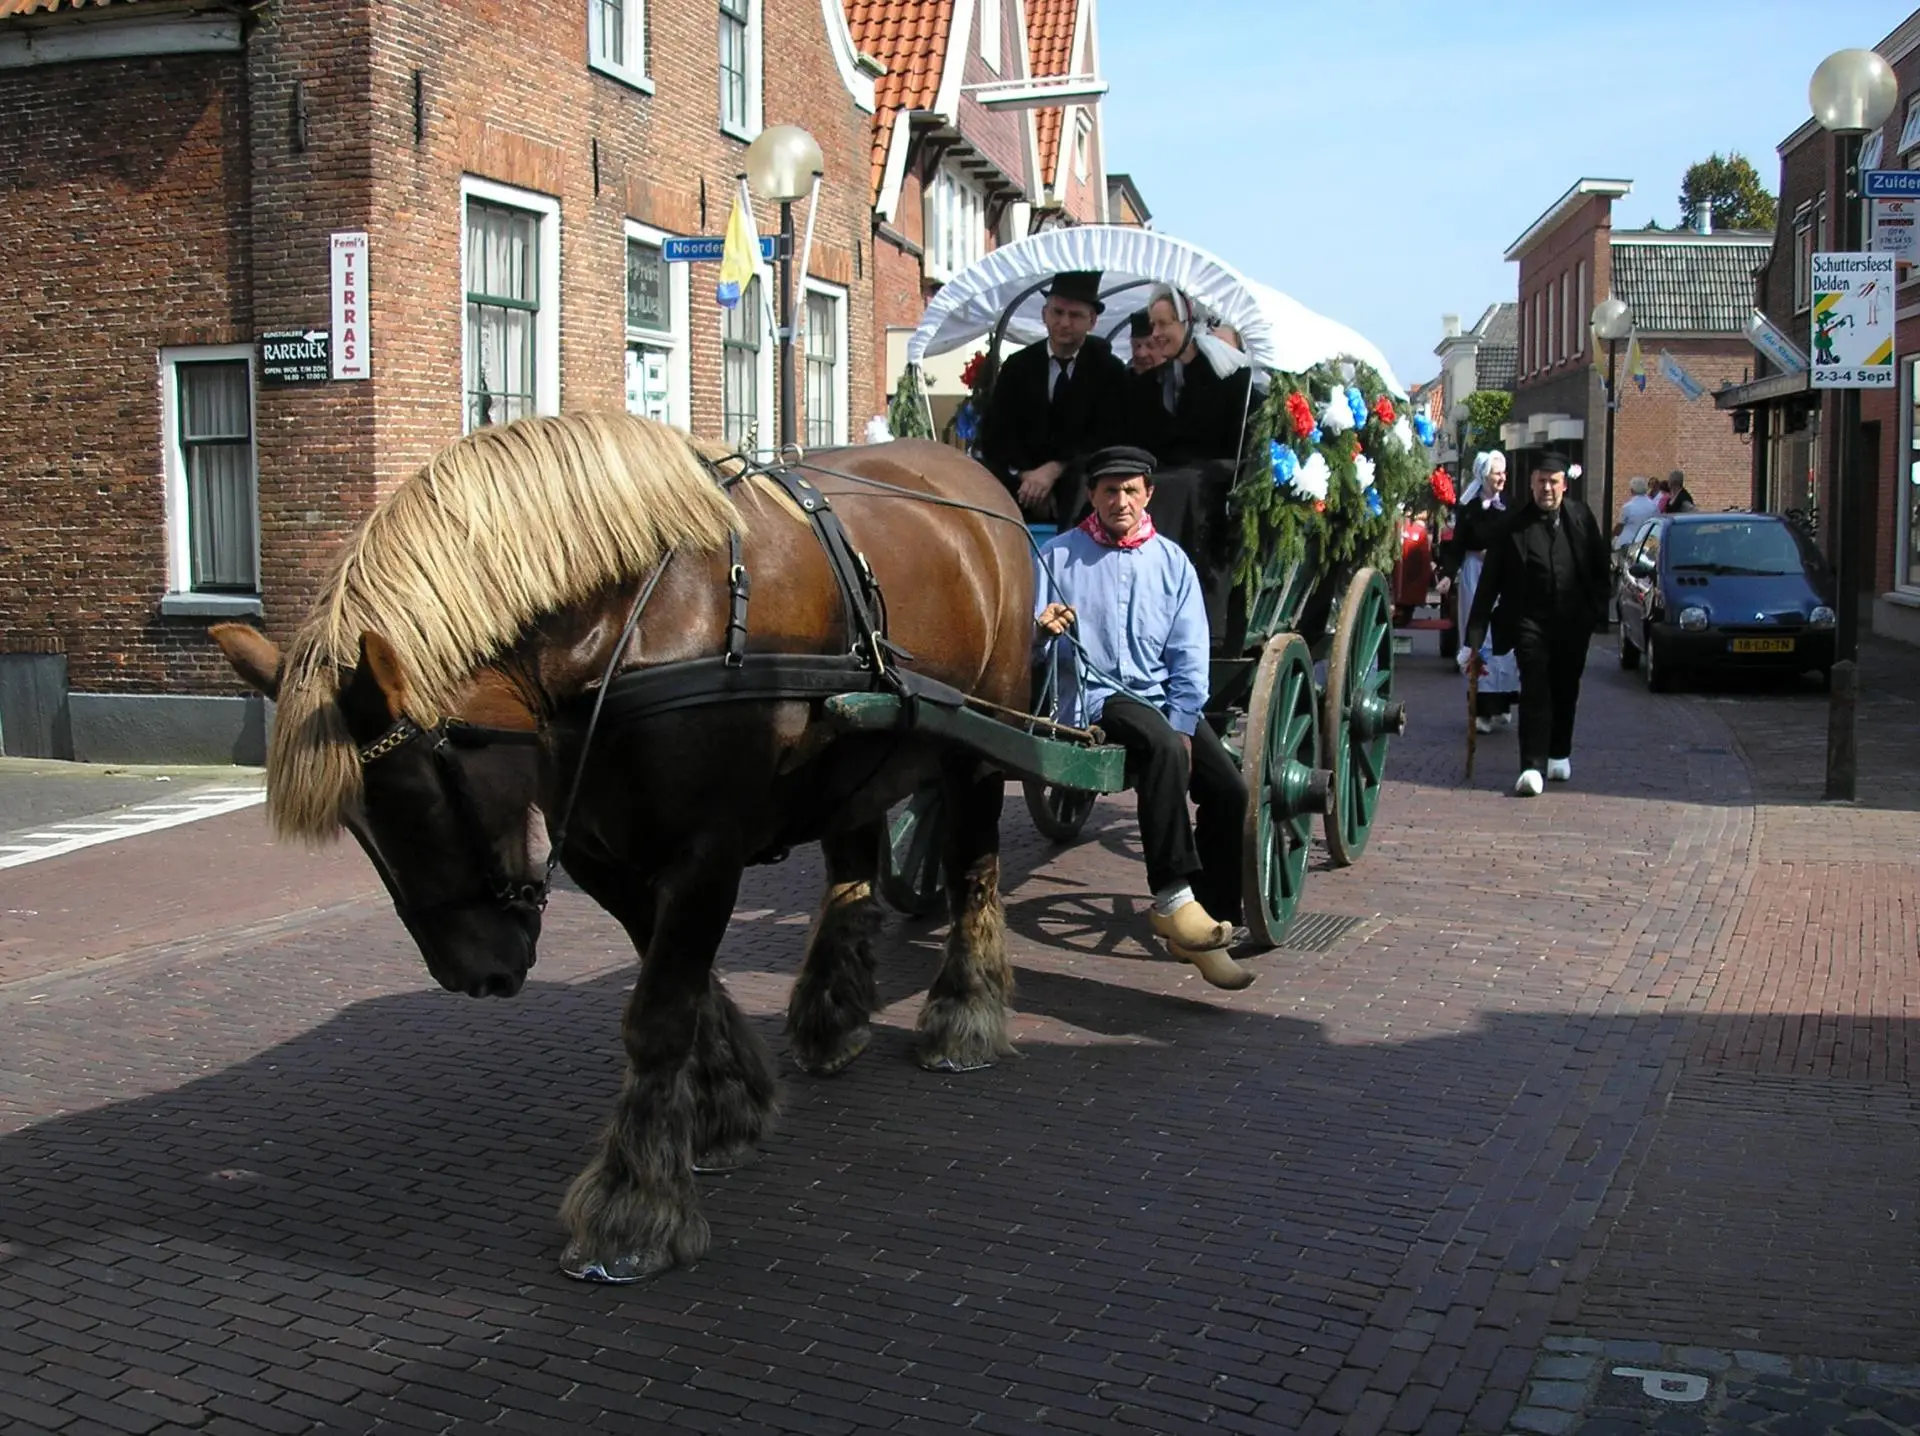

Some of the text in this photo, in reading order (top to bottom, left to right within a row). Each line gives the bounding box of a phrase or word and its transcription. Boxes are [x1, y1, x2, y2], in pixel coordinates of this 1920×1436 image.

[1814, 256, 1892, 272] Schuttersfeest
[1814, 276, 1850, 291] Delden
[344, 253, 356, 360] TERRAS
[1815, 371, 1892, 383] 2-3-4 Sept
[1611, 1367, 1709, 1402] P
